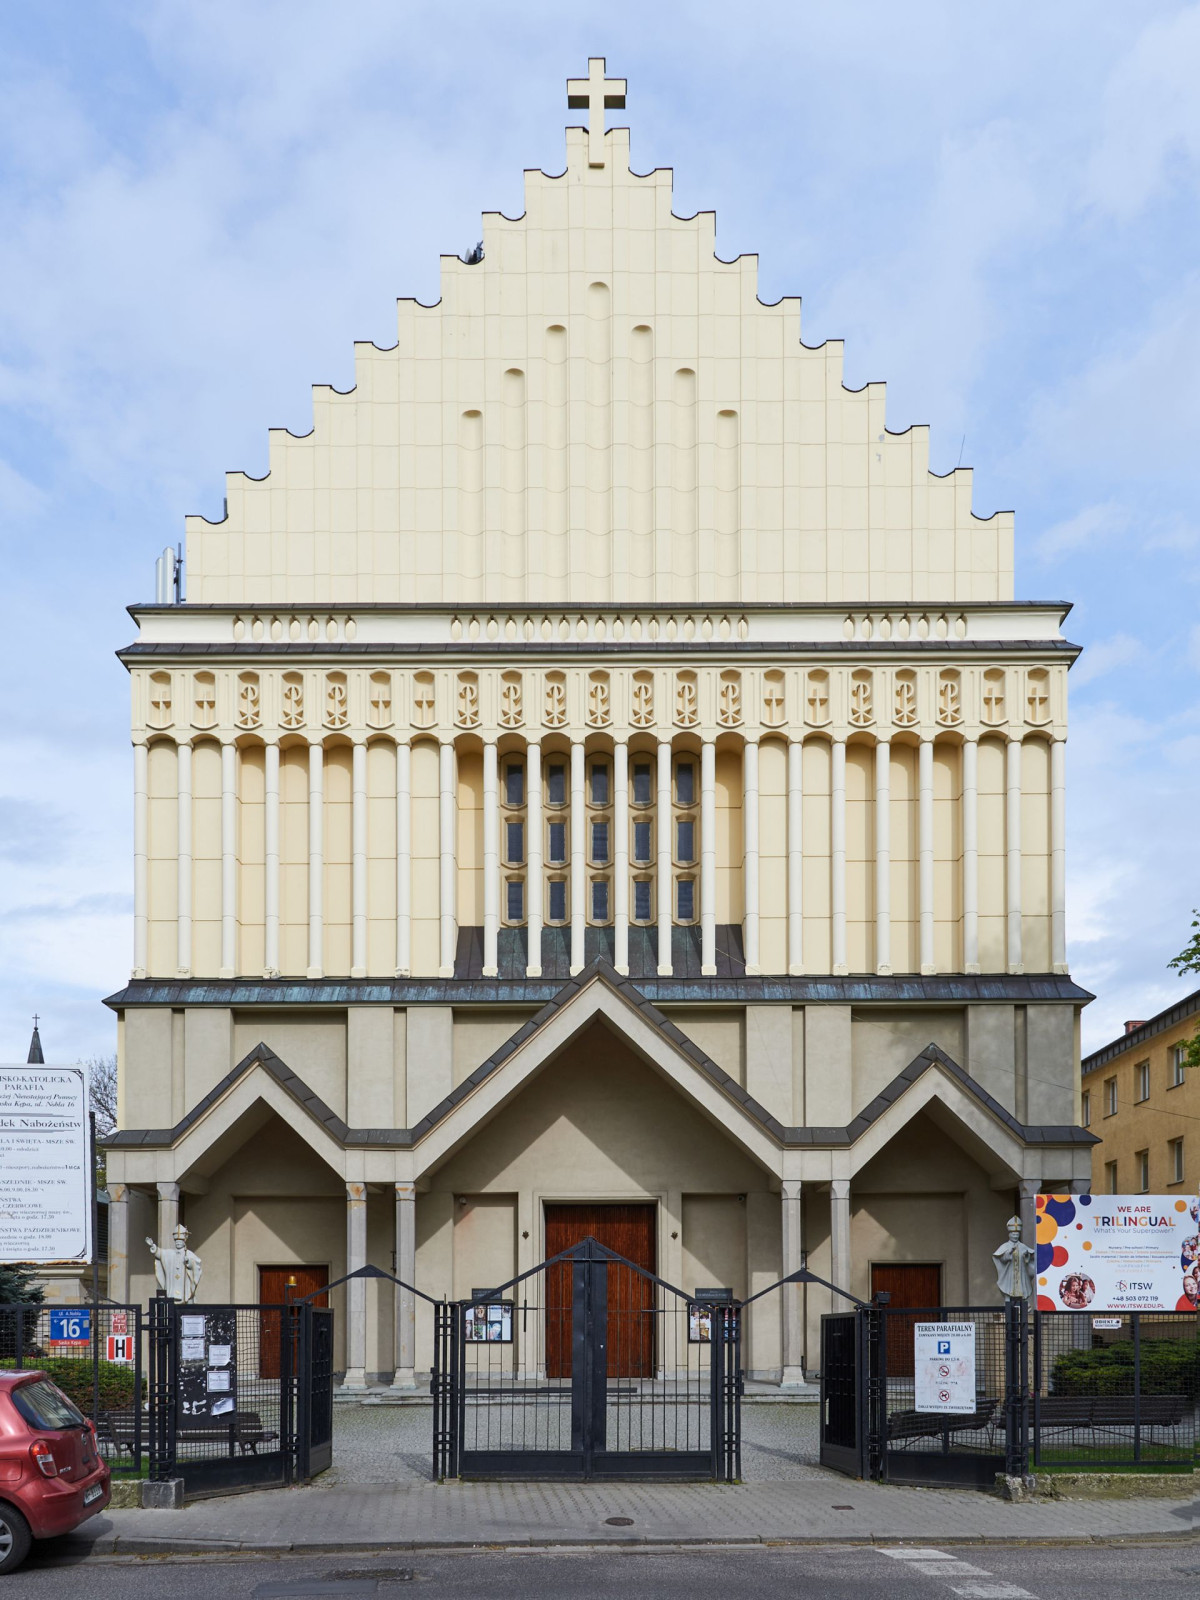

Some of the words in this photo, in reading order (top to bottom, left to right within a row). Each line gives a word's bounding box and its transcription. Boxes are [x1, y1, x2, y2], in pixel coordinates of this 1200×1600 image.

[20, 1119, 82, 1128] Nabożeństw
[1093, 1216, 1176, 1227] TRILINGUAL
[1132, 1227, 1175, 1235] Superpower?
[1129, 1282, 1153, 1290] ITSW
[60, 1318, 80, 1338] 16
[115, 1339, 125, 1358] H
[940, 1342, 949, 1353] P
